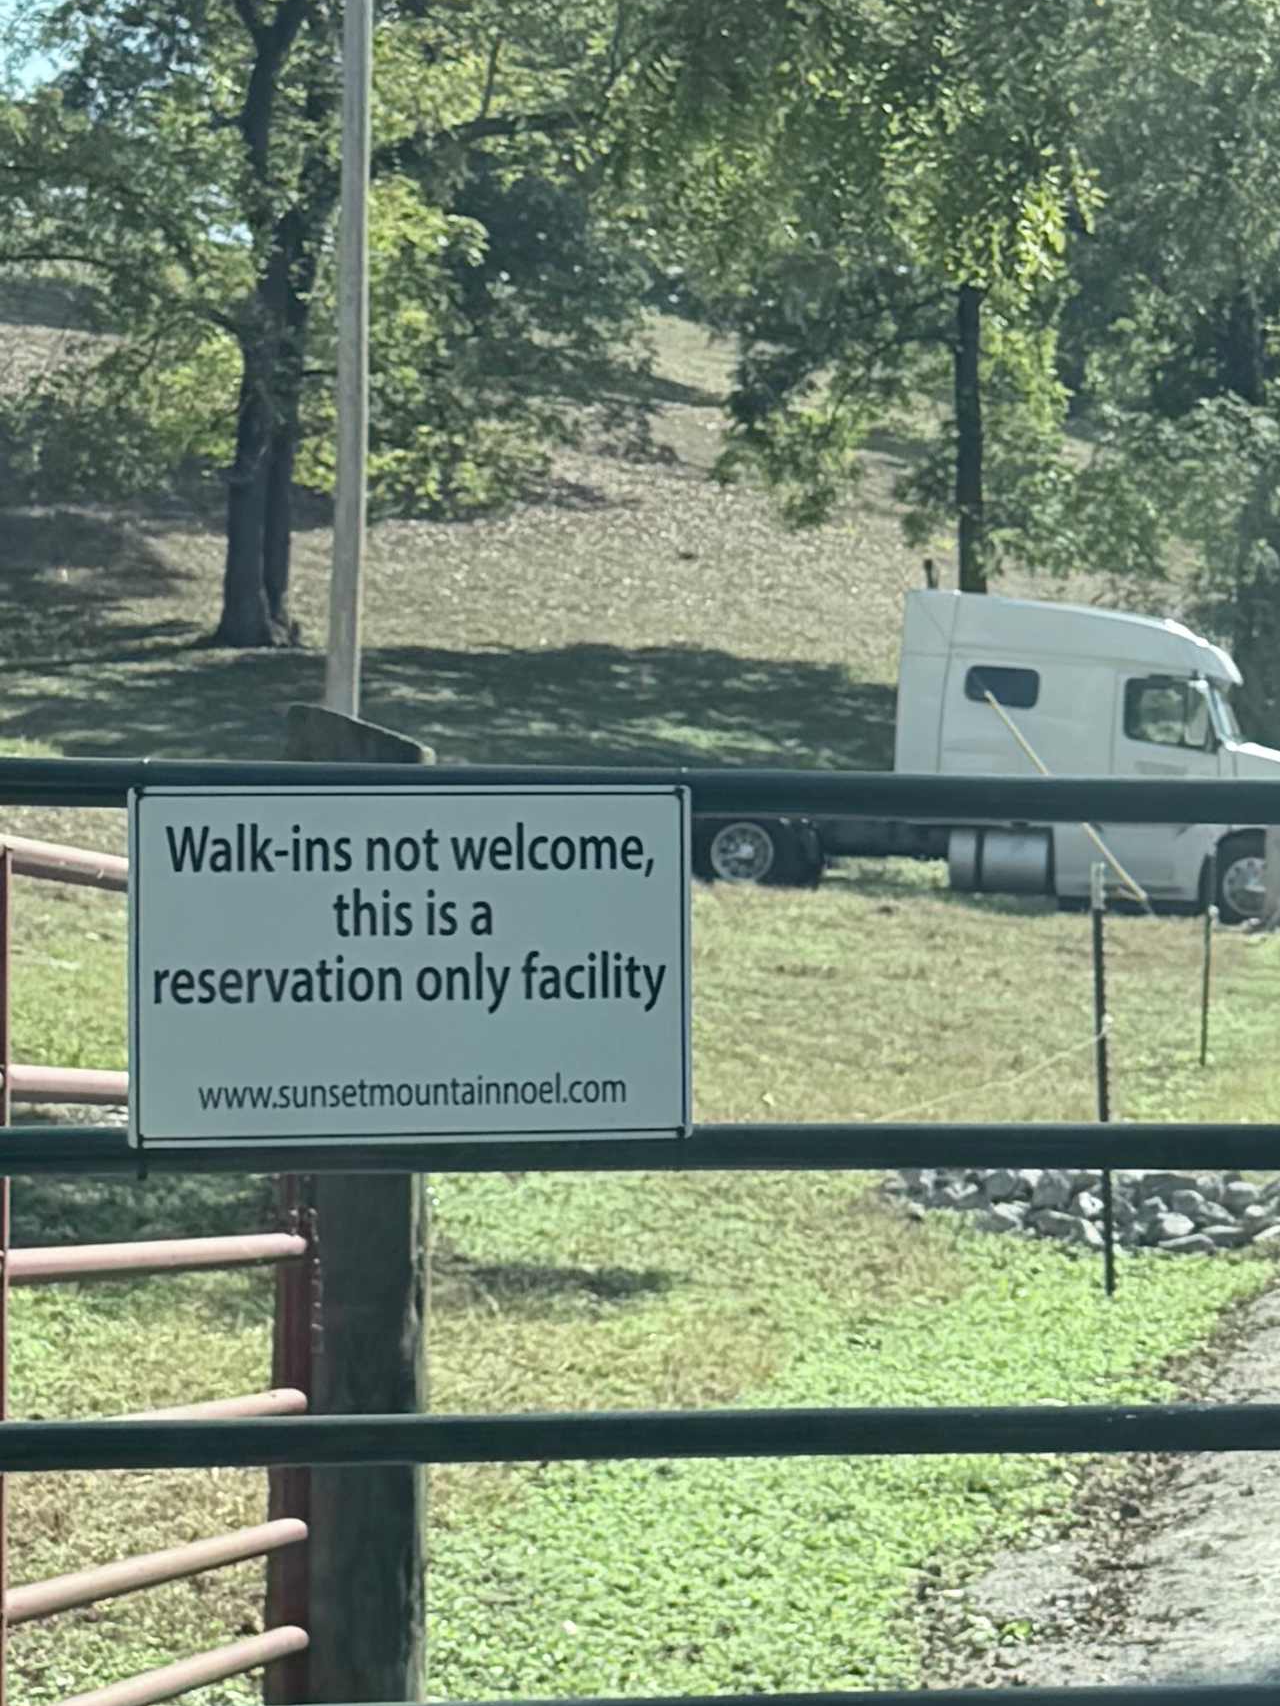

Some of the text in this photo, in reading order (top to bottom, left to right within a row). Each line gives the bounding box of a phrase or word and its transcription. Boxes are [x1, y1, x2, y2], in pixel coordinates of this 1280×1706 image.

[165, 822, 655, 877] Walk-ins not welcome,
[333, 888, 493, 937] this is a
[153, 950, 667, 1014] reservation only facility
[198, 1072, 627, 1110] www.sunsetmountainnoel.com
